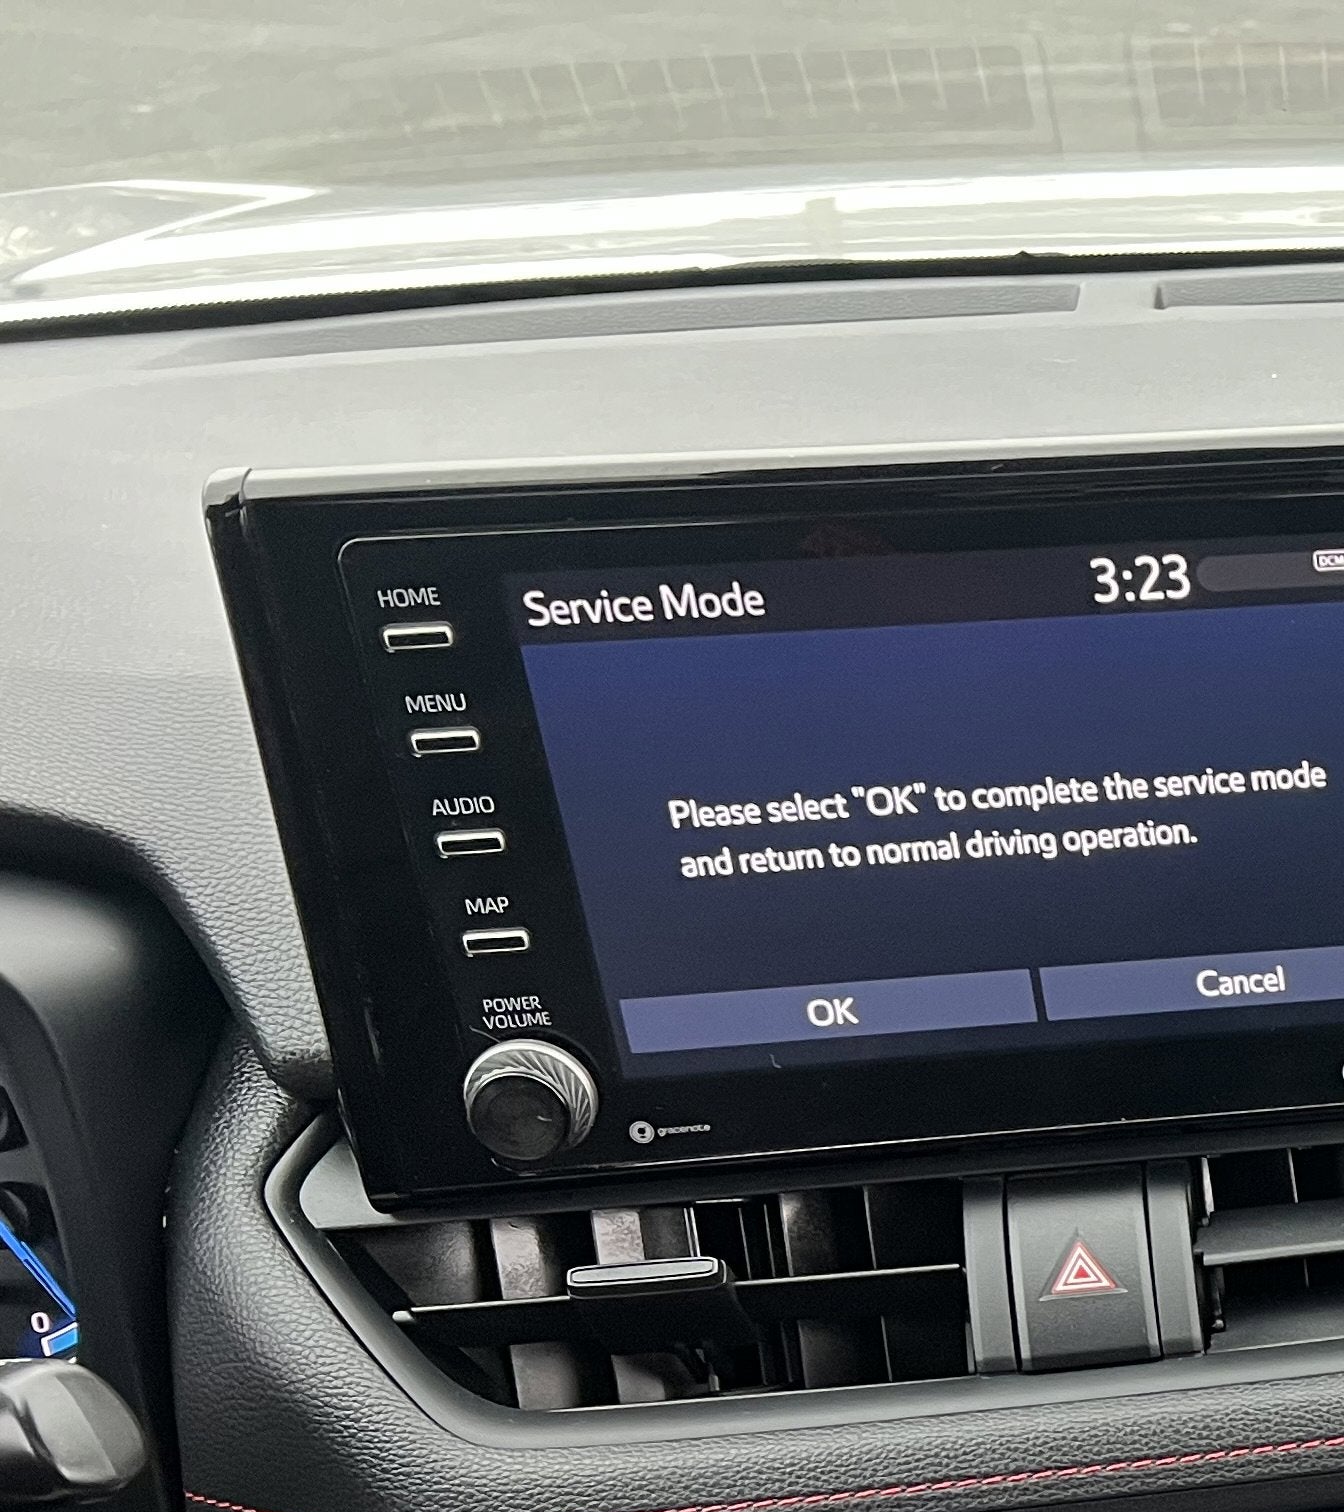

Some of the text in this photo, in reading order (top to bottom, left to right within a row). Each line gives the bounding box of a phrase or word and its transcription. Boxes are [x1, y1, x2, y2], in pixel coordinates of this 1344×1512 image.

[377, 587, 441, 608] HOME
[523, 553, 1192, 628] Service Mode 3:23
[405, 694, 467, 714] MENU
[432, 796, 495, 816] AUDIO
[668, 760, 1327, 830] Please select "OK" to complete the service mode
[681, 818, 1199, 880] and return to normal driving operation.
[465, 897, 509, 916] MAP
[1196, 966, 1286, 997] Cancel
[483, 996, 542, 1013] POWER
[807, 998, 858, 1027] OK
[483, 1009, 552, 1029] VOLUME
[31, 1311, 51, 1334] 0
